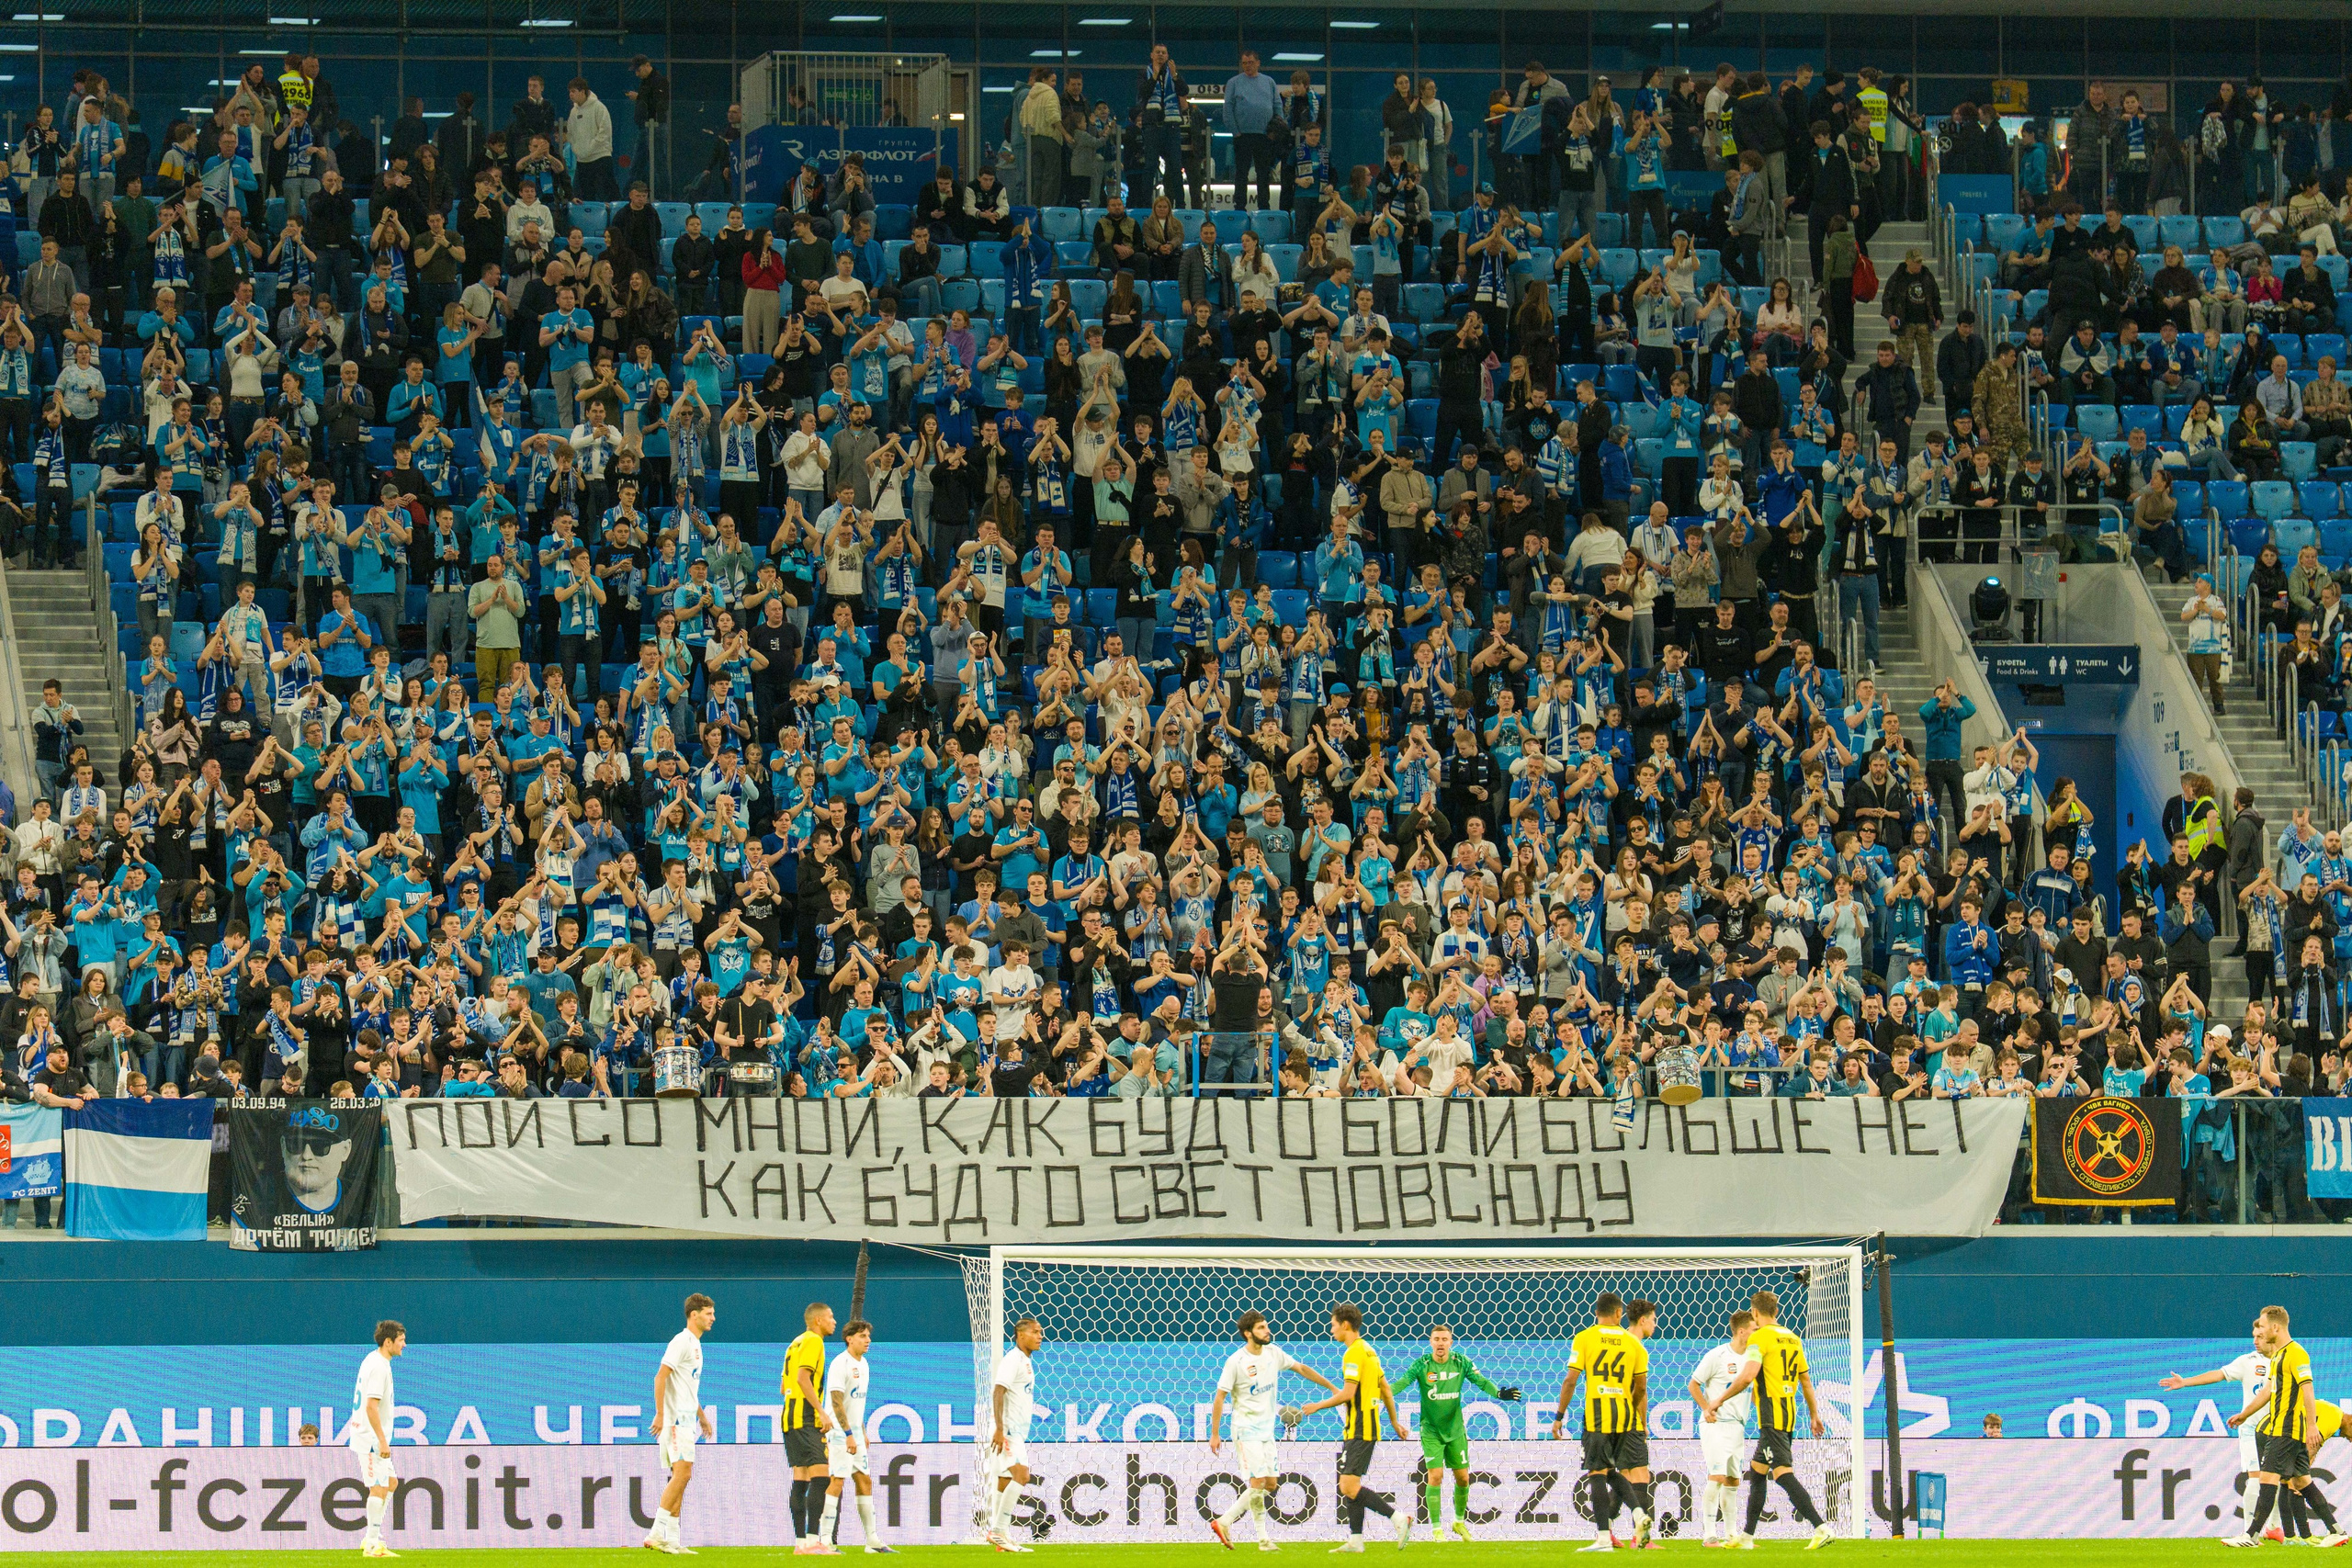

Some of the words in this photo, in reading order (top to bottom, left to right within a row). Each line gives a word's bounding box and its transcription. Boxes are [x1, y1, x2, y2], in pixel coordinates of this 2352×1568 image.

[2153, 701, 2165, 724] 109
[232, 1097, 287, 1109] 03.09.94
[2087, 1100, 2102, 1111] ЧВК
[2103, 1100, 2131, 1111] ВАГНЕР
[288, 1106, 339, 1133] 1980
[568, 1099, 662, 1147] СО
[919, 1097, 1064, 1157] КАК
[1088, 1097, 1317, 1161] БУДТО
[1341, 1097, 1519, 1159] БОЛИ
[1539, 1097, 1831, 1156] БОЛЬШЕ
[1853, 1097, 1972, 1155] НЕТ
[2067, 1114, 2081, 1137] КРОВЬ
[2140, 1118, 2153, 1145] ОТВАГА
[2066, 1144, 2076, 1169] ЧЕСТЬ
[2136, 1148, 2152, 1177] РОДИНА
[12, 1189, 26, 1198] FC
[28, 1186, 57, 1197] ZENIT
[2079, 1171, 2136, 1192] СПРАВЕДЛИВОСТЬ
[698, 1160, 836, 1224] КАК
[862, 1162, 1086, 1242] БУДТО
[1111, 1160, 1273, 1224] СВЕТ
[1300, 1160, 1634, 1234] ПОВСЮДУ
[232, 1225, 301, 1248] АРТЁМ
[309, 1226, 378, 1248] ТАНАЕ
[1592, 1349, 1626, 1383] 44
[1781, 1348, 1799, 1382] 14
[535, 1402, 1297, 1443] ЧЕПОНКОГ
